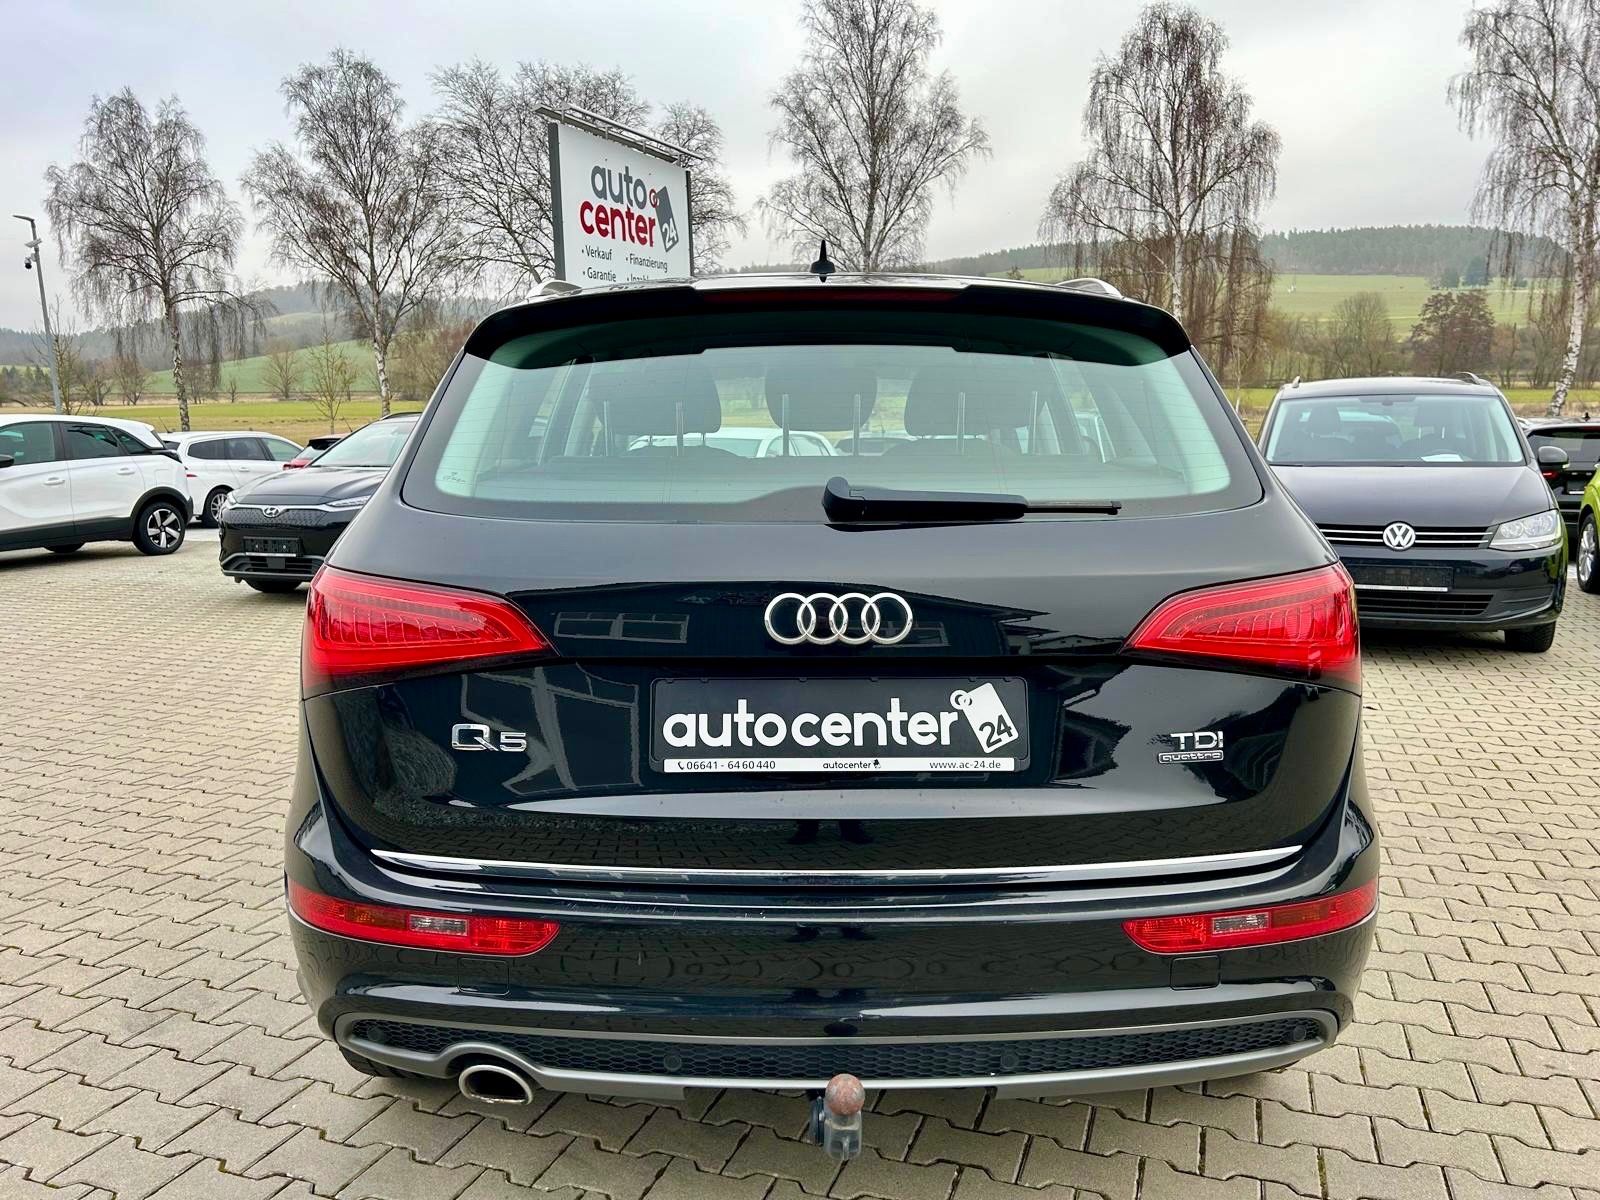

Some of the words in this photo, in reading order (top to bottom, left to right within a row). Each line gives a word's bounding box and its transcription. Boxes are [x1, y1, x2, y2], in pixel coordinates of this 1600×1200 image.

[591, 165, 647, 210] auto
[579, 200, 656, 247] center
[662, 217, 677, 247] 24
[585, 245, 613, 261] Verkauf
[629, 253, 668, 273] Finanzierung
[587, 267, 617, 283] Garantie
[451, 723, 527, 752] Q5
[978, 713, 1014, 748] 24
[1170, 731, 1224, 750] TDI
[686, 761, 718, 770] 06641
[822, 760, 871, 769] autocenter
[929, 760, 1001, 769] www.ac-24.de
[1162, 752, 1221, 762] quattro
